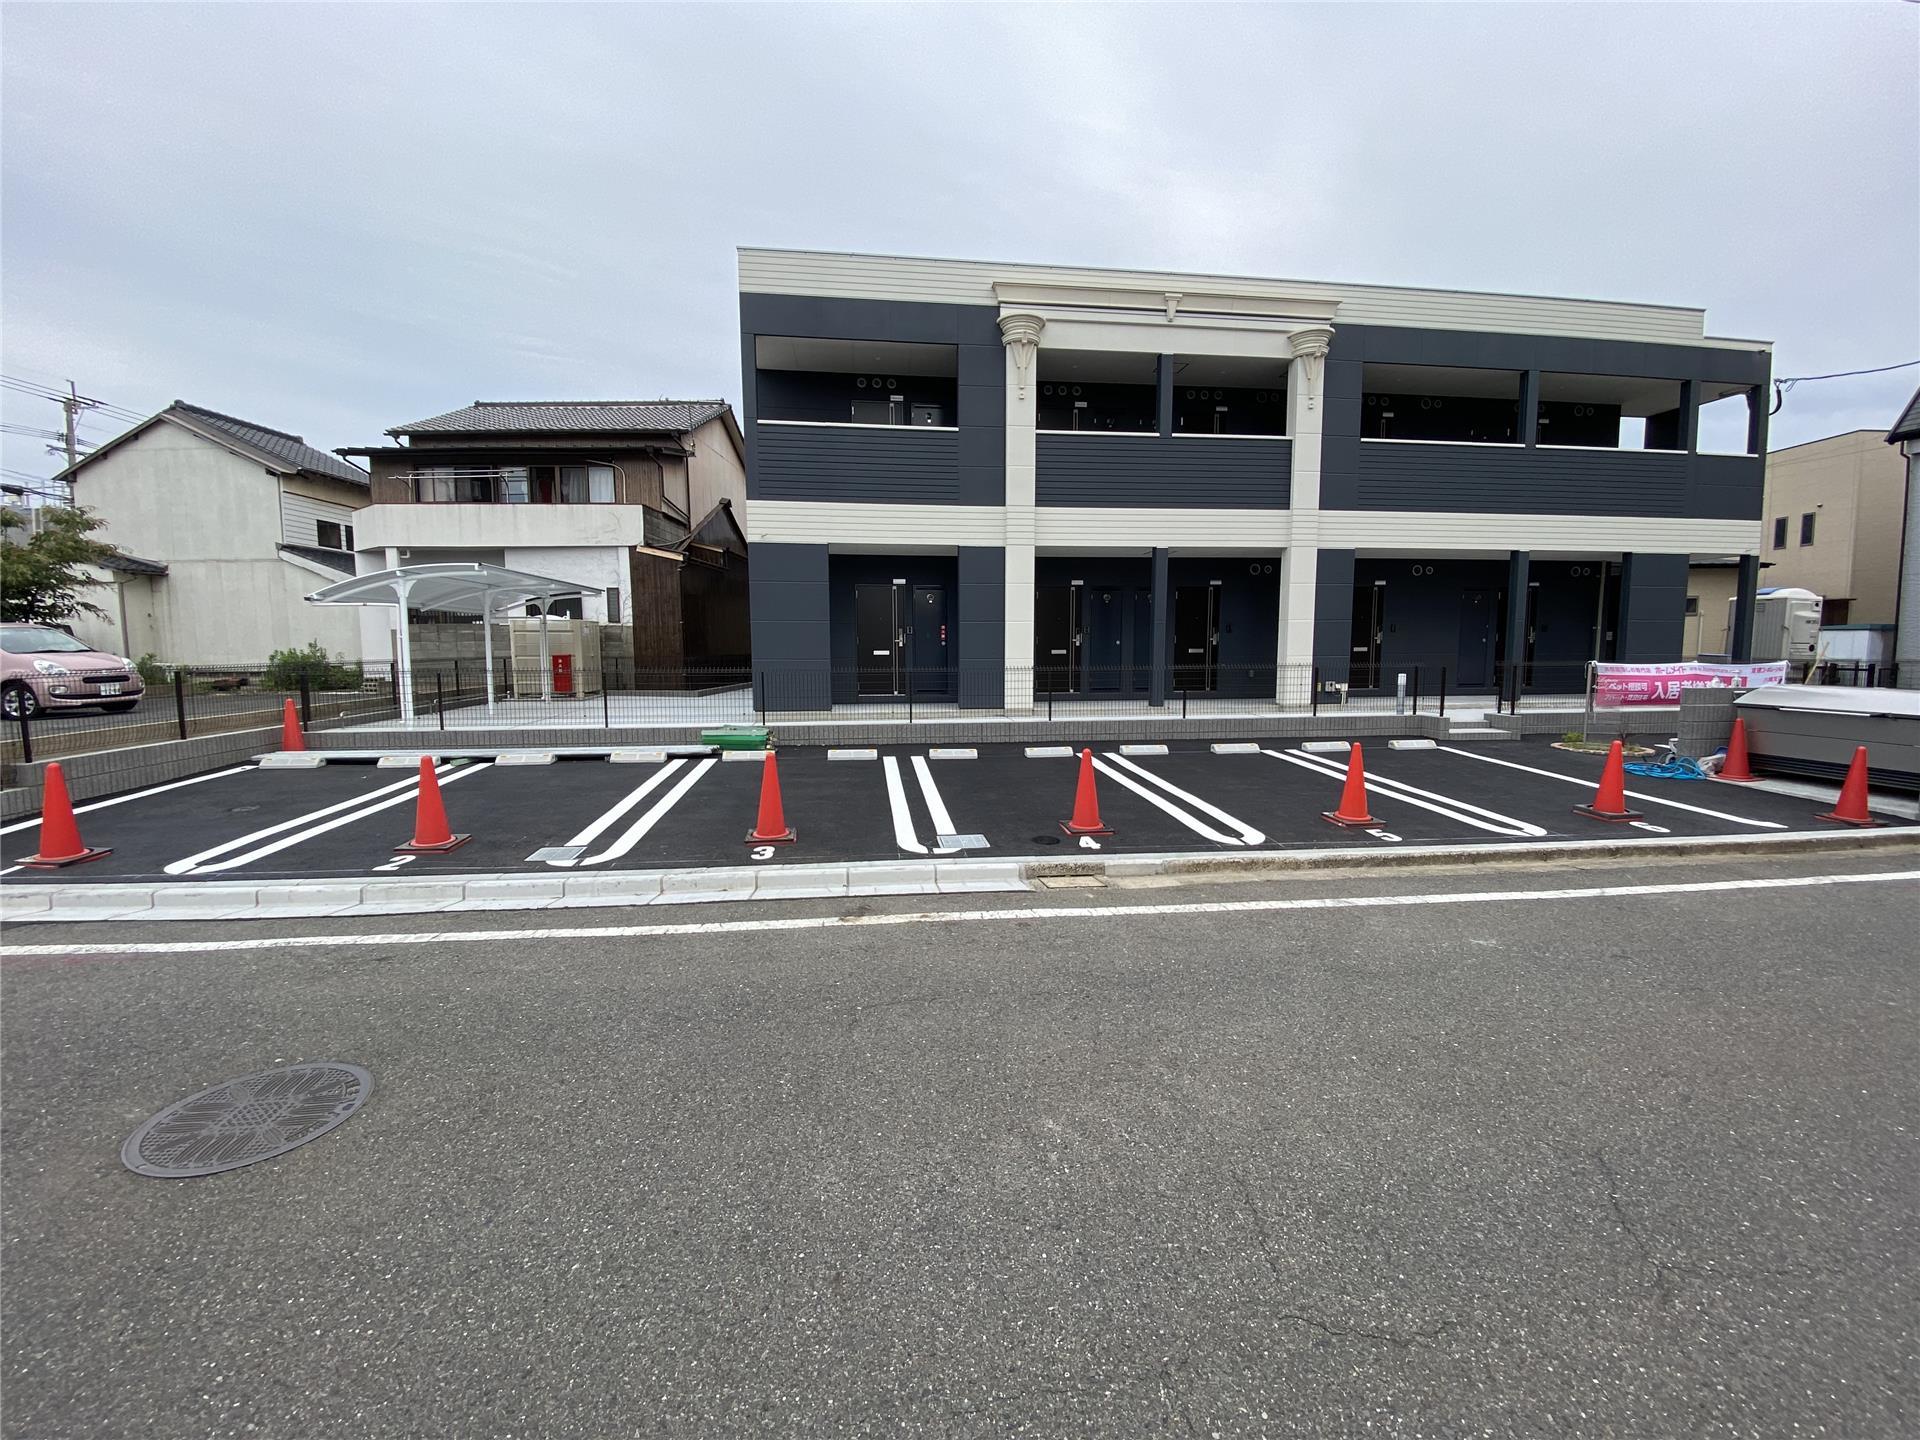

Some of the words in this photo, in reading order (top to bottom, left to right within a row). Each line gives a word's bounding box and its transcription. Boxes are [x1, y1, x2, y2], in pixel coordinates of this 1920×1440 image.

[1629, 821, 1671, 833] 6
[1078, 835, 1102, 850] 4
[1364, 828, 1403, 842] 5
[750, 845, 776, 860] 3
[371, 854, 417, 871] 2
